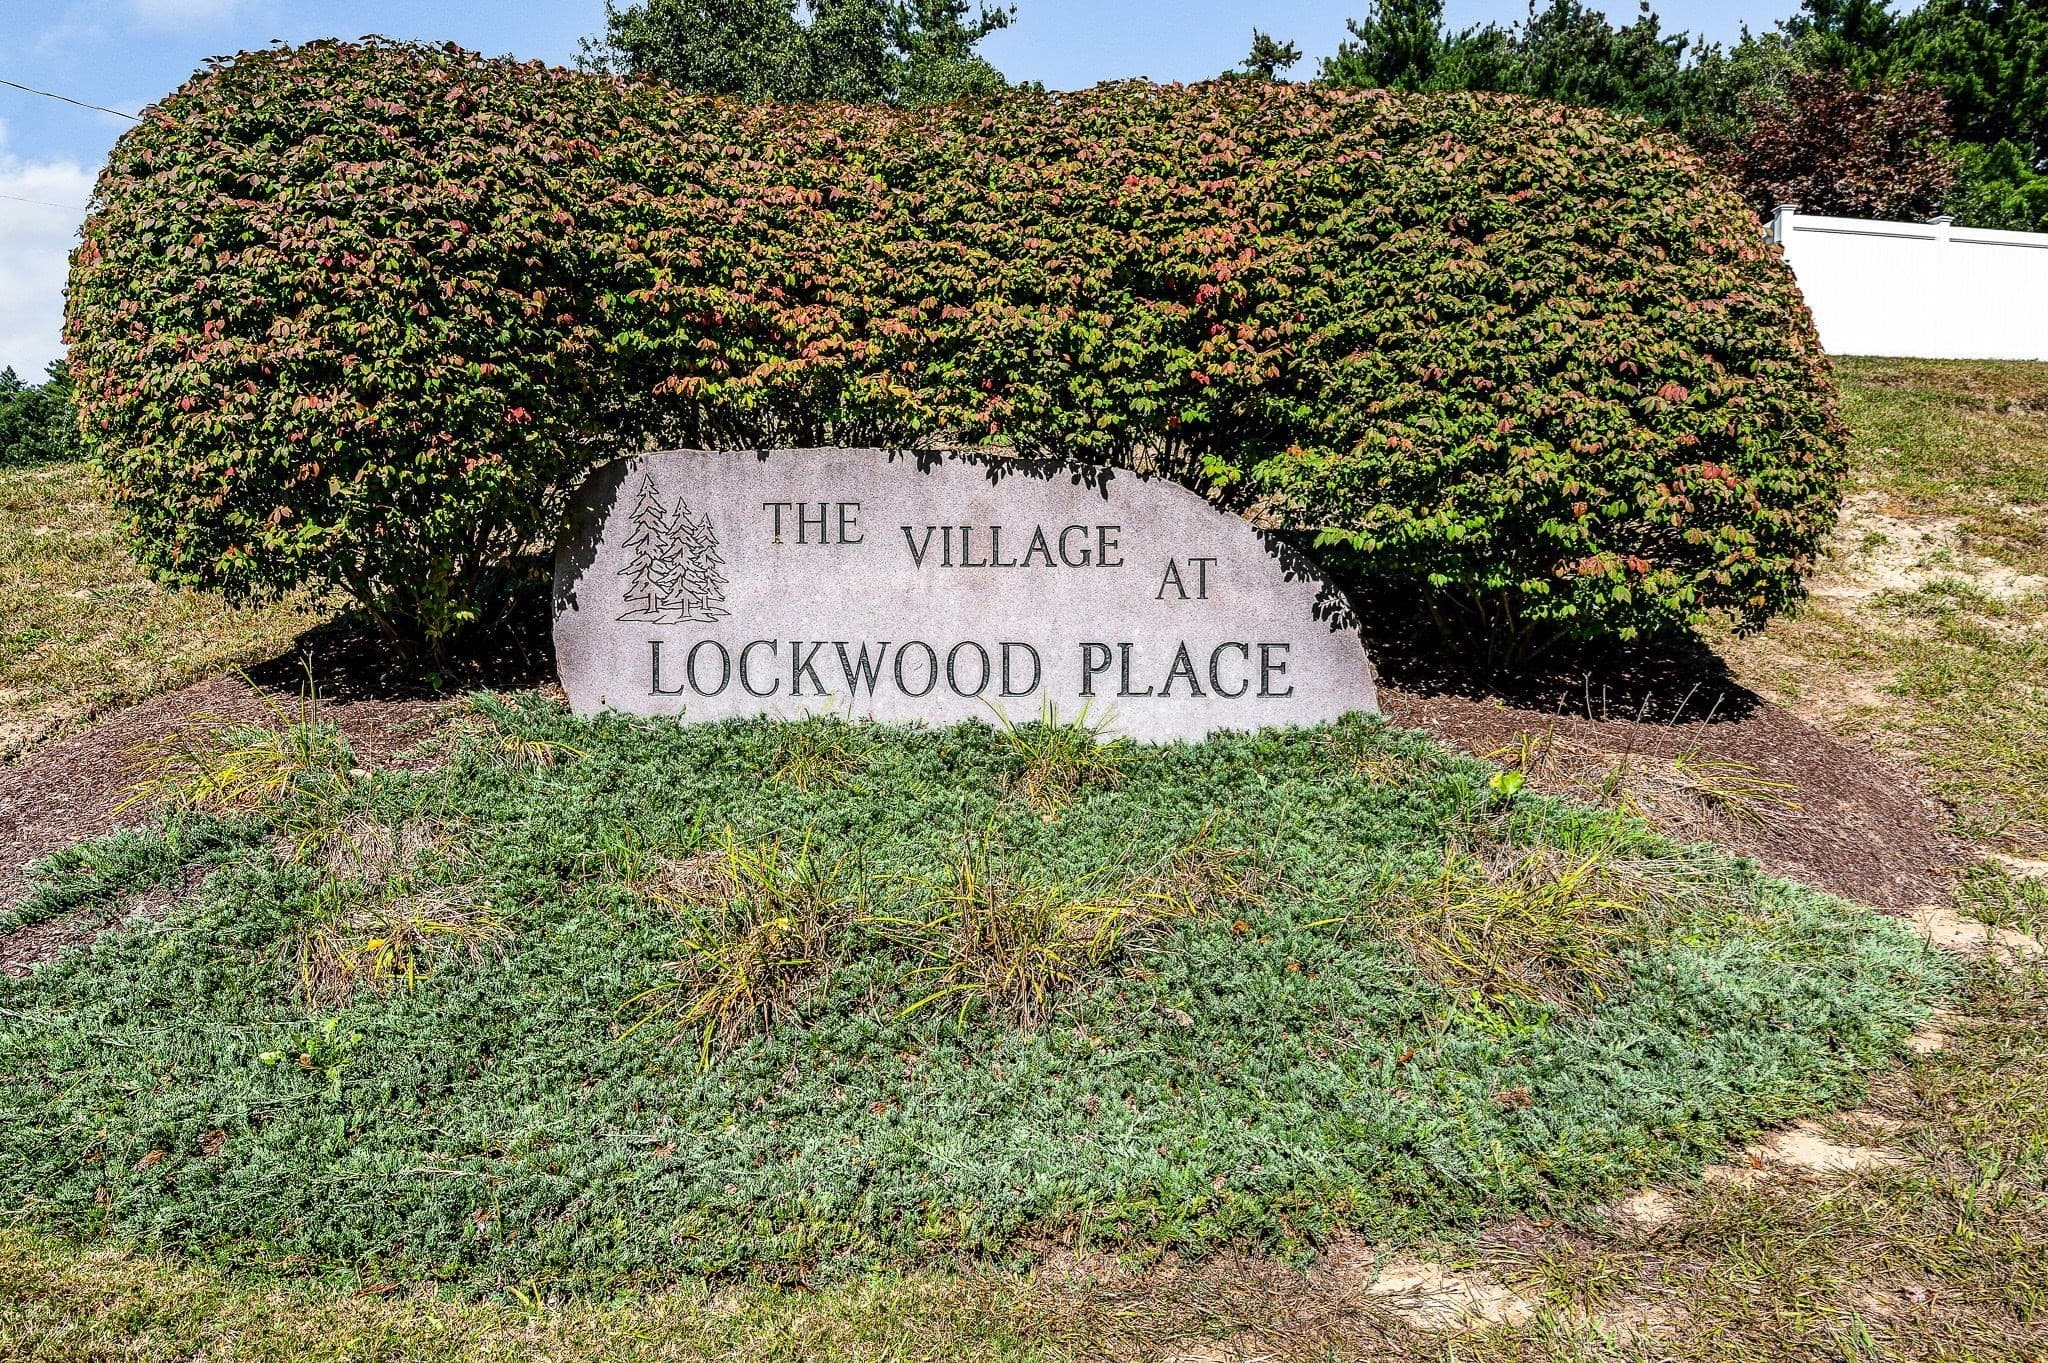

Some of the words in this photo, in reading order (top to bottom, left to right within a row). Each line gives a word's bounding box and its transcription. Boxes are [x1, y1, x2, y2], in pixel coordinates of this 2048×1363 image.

[762, 501, 865, 544] THE
[900, 525, 1124, 568] VILLAGE
[1156, 557, 1217, 600] AT
[648, 640, 1042, 697] LOCKWOOD
[1079, 641, 1295, 699] PLACE
